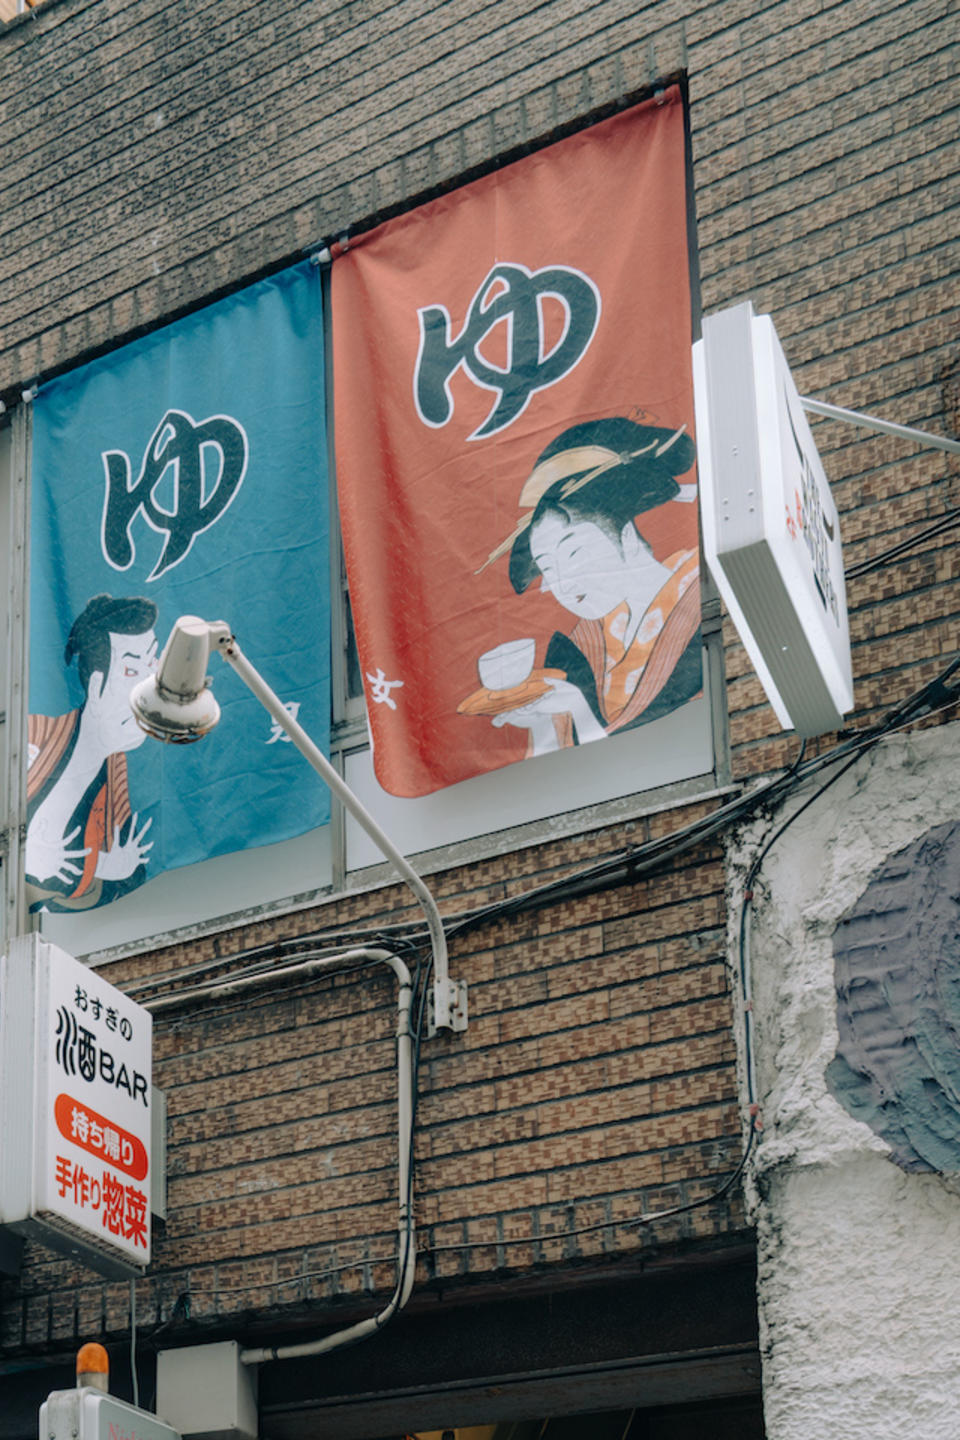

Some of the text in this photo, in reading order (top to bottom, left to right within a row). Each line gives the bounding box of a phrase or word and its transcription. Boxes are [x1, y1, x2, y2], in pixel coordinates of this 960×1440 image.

[413, 262, 602, 442] ゆ
[101, 408, 250, 583] ゆ
[366, 668, 405, 711] 女
[74, 984, 133, 1042] おすぎの
[71, 1106, 135, 1166] 持ち帰り
[55, 1155, 148, 1249] 手作り惣菜
